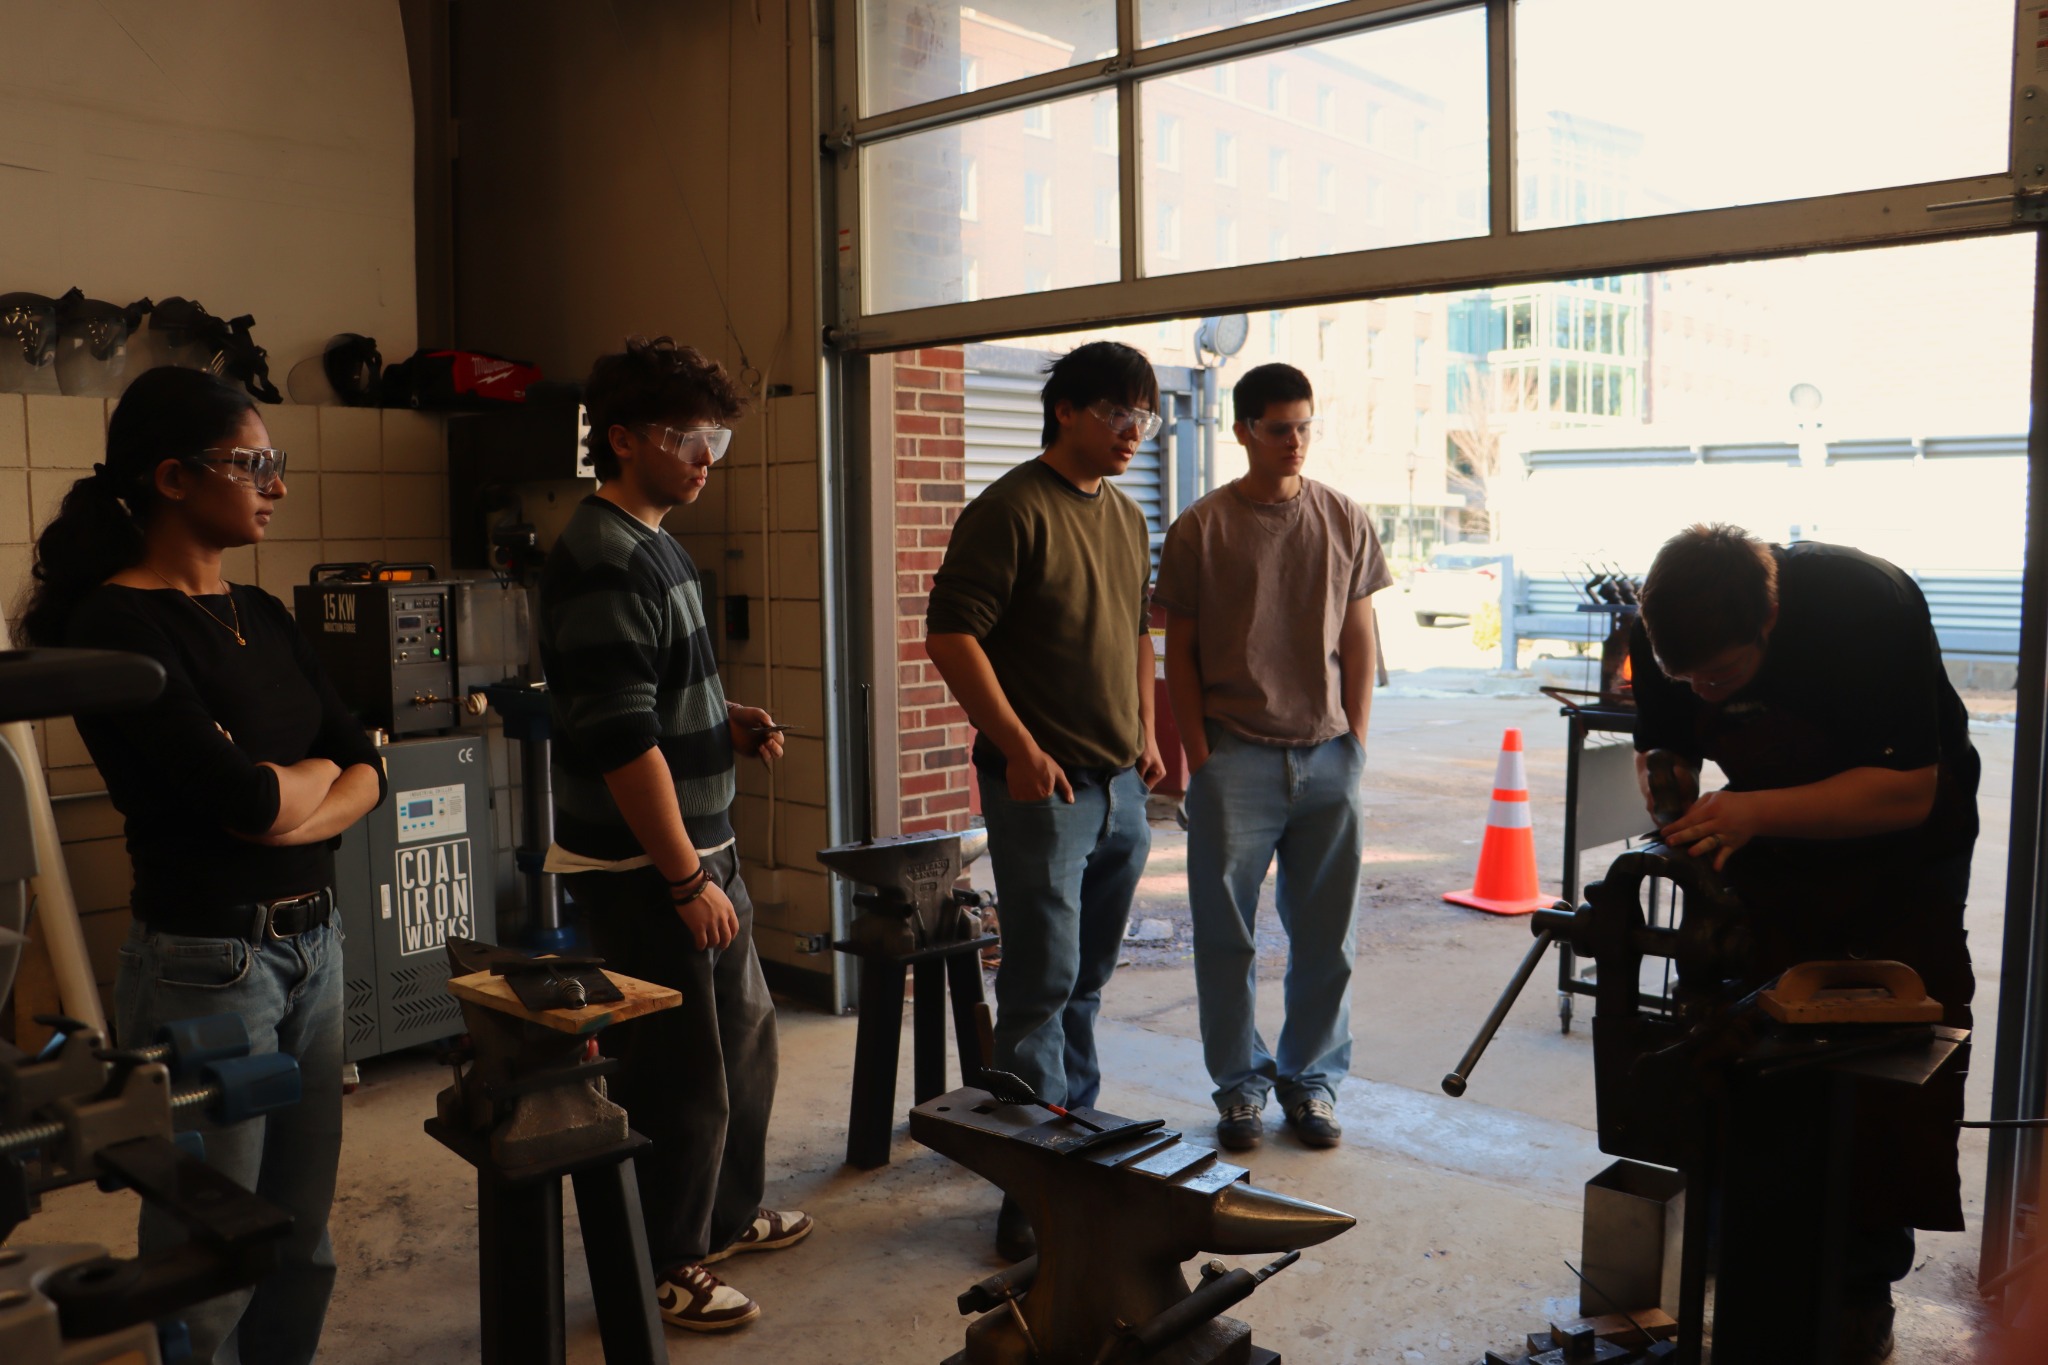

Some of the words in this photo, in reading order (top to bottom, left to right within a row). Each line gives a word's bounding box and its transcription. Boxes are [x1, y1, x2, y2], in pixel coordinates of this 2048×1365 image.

[323, 593, 336, 620] 15
[338, 593, 356, 621] KW
[458, 747, 473, 763] CE
[400, 843, 467, 890] COAL
[403, 879, 469, 927] IRON
[405, 915, 470, 951] WORKS
